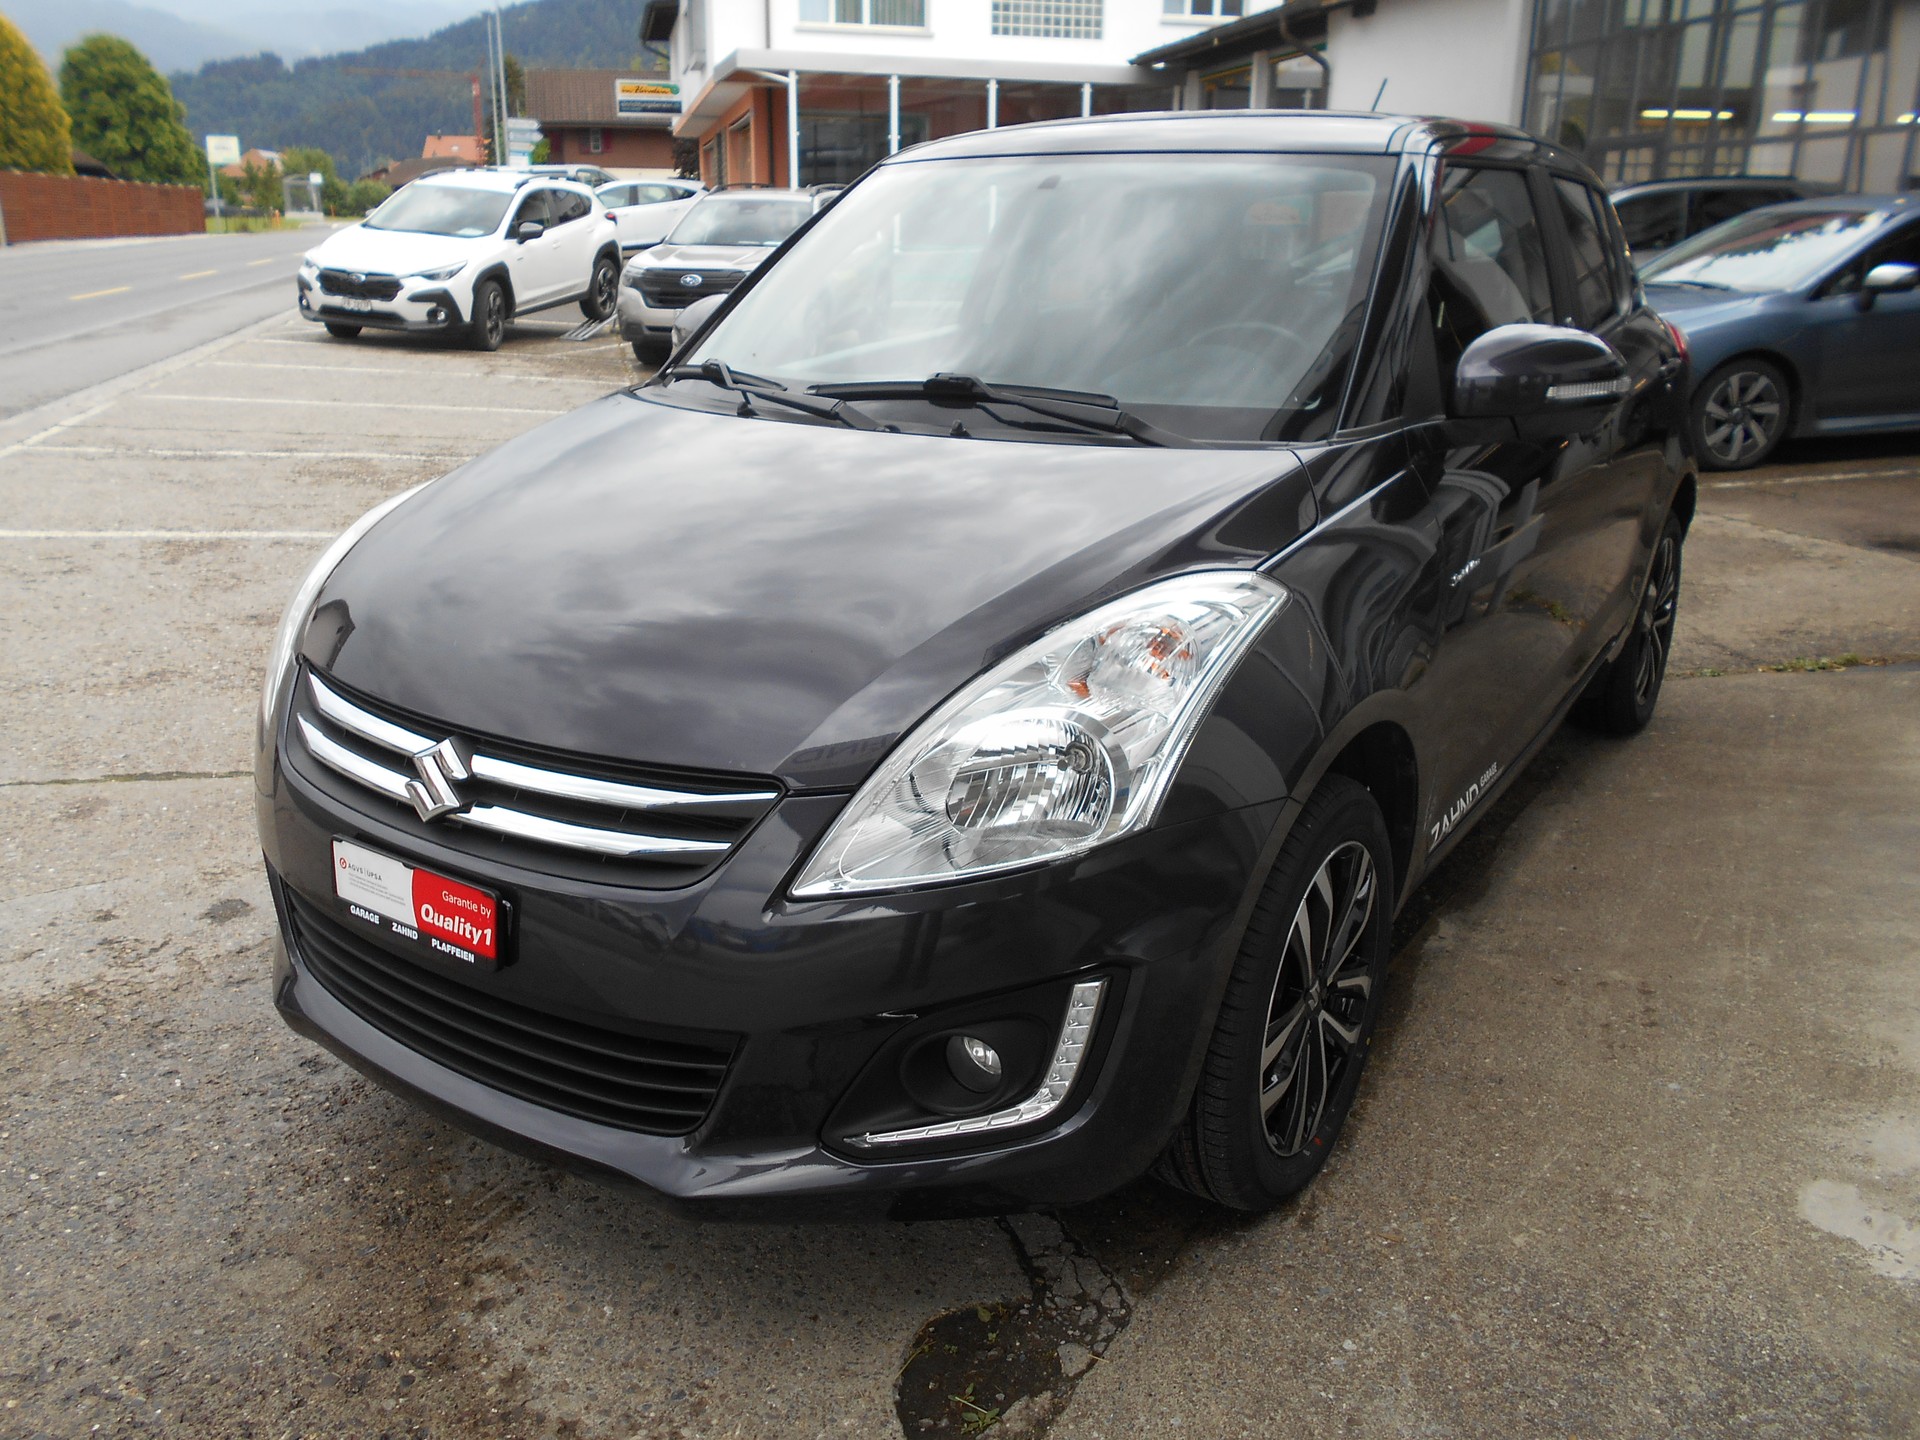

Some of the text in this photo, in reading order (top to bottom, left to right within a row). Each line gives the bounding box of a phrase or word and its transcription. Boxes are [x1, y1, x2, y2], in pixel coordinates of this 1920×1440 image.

[1480, 762, 1498, 787] GARAGE
[348, 863, 383, 881] AGVS UPSA
[442, 890, 492, 919] Garantie by
[350, 904, 475, 964] GARAGE ZAHND PLAFFEIEN
[420, 903, 492, 946] Quality1
